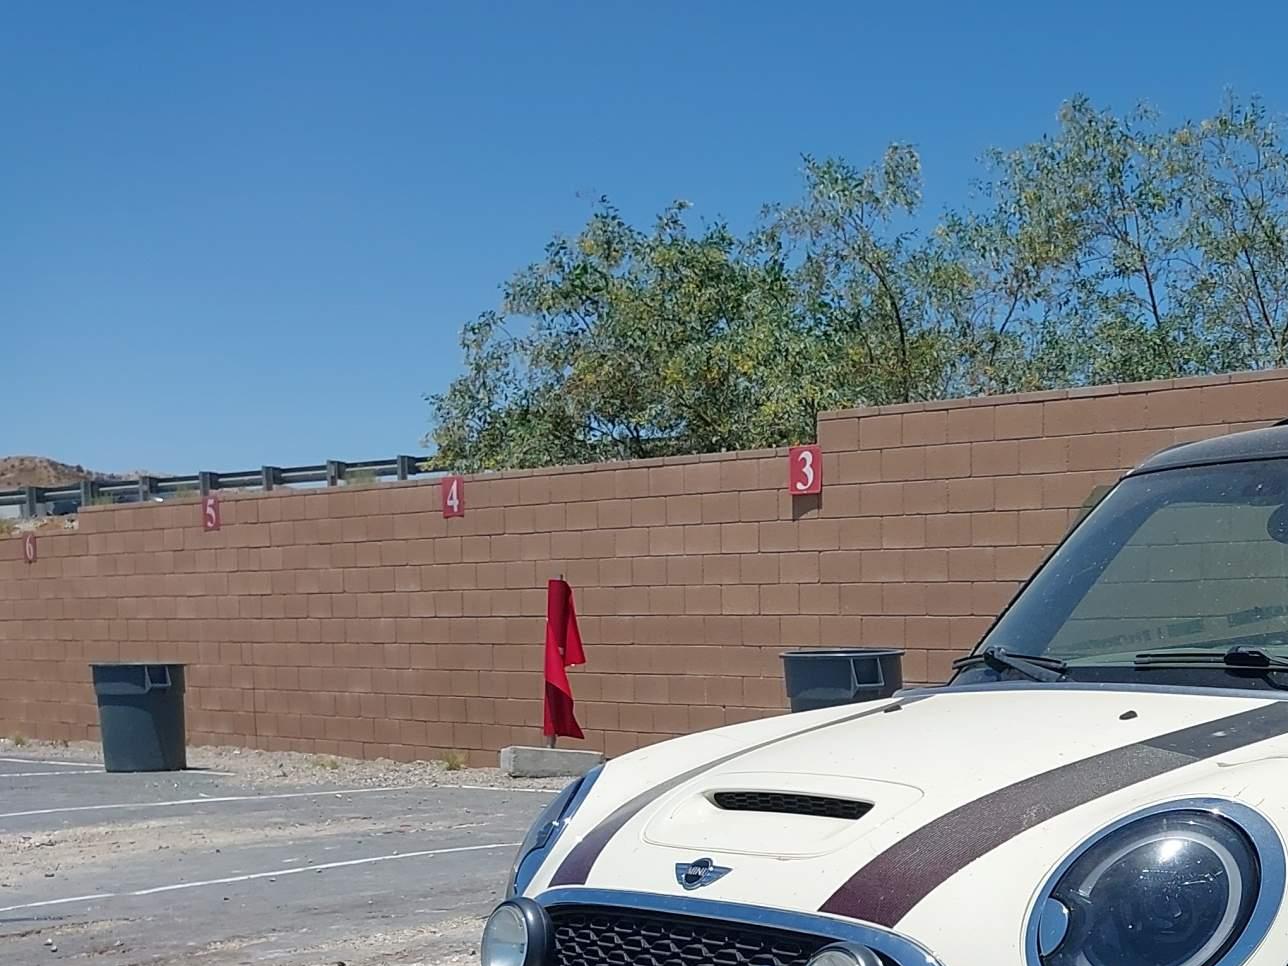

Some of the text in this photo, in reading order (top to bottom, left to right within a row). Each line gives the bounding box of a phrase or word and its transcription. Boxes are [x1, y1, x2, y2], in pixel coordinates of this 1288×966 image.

[796, 450, 814, 490] 3
[447, 479, 459, 512] 4
[206, 498, 216, 527] 5
